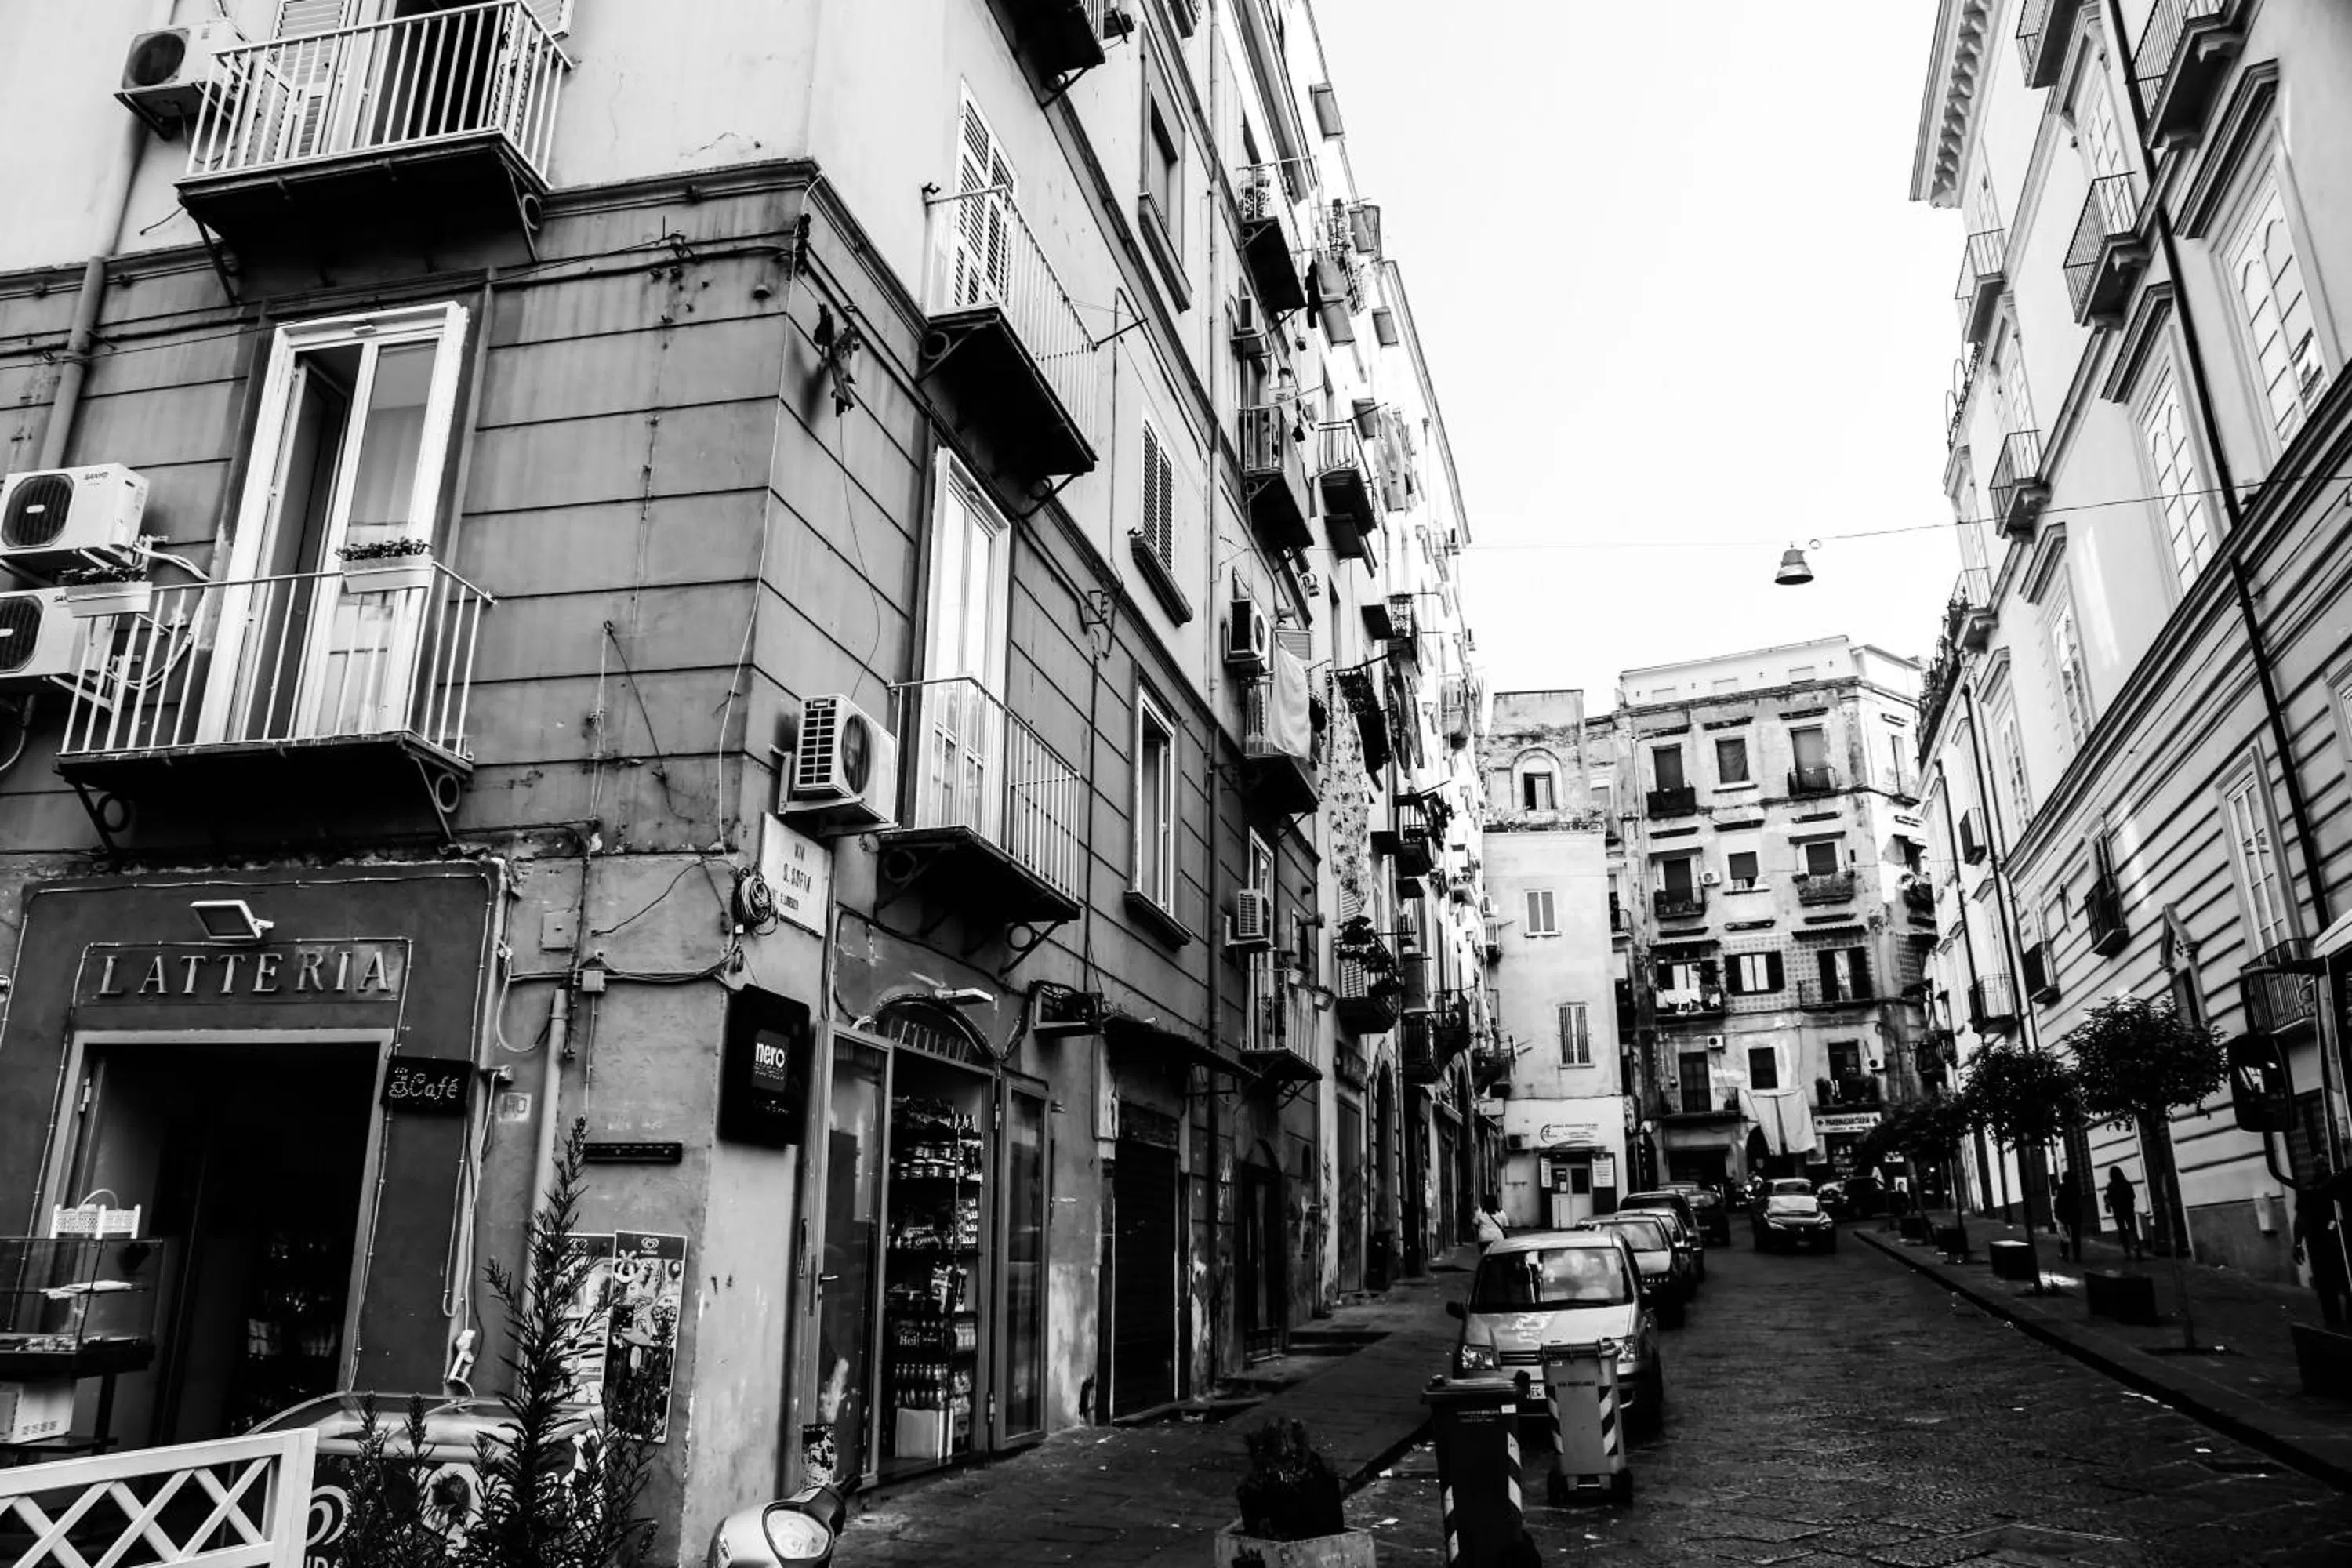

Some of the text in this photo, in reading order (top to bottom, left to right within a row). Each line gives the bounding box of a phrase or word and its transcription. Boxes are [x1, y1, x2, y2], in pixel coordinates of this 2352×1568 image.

[794, 842, 805, 862] VIA
[791, 867, 811, 894] SOFIA
[99, 949, 393, 995] LATTERIA
[755, 1042, 785, 1068] nero
[409, 1072, 459, 1100] Café
